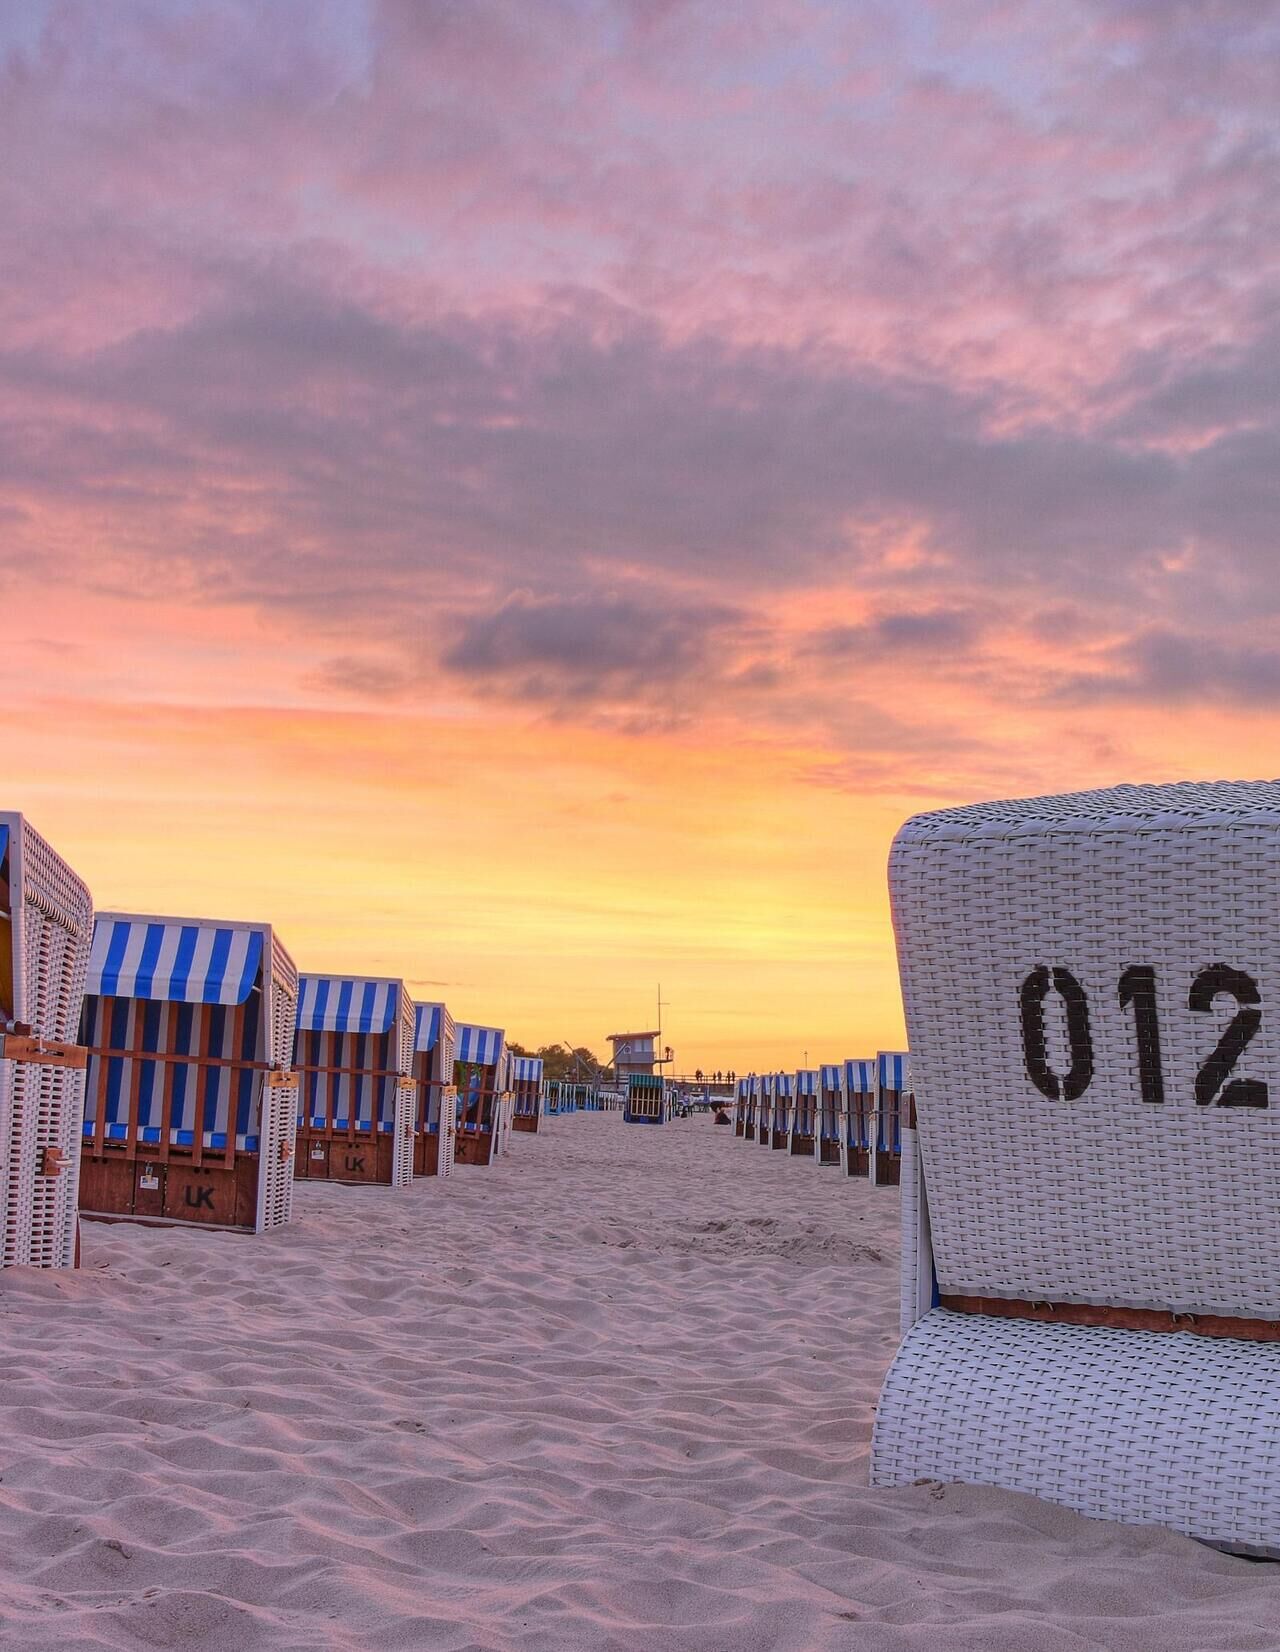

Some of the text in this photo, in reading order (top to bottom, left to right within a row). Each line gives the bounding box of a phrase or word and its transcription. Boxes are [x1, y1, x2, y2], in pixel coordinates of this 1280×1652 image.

[1020, 962, 1268, 1107] 012
[345, 1156, 366, 1172] UK
[185, 1184, 215, 1210] UK
